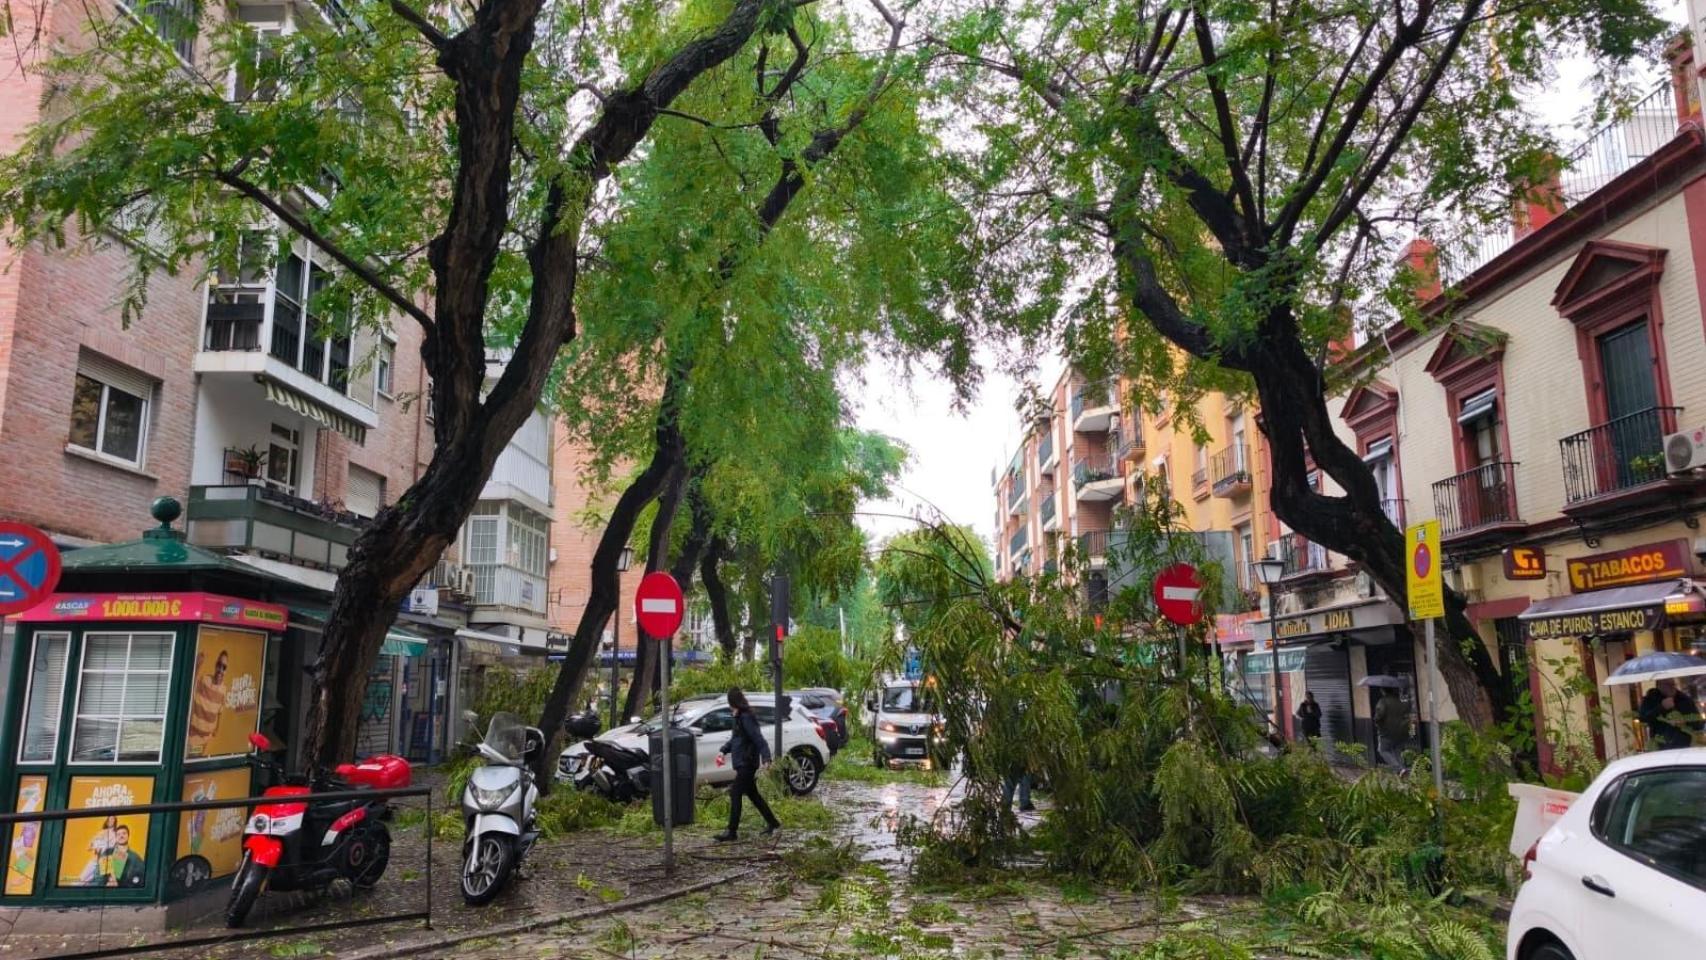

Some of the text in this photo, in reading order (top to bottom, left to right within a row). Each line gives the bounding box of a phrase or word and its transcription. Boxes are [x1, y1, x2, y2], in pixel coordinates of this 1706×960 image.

[1593, 552, 1665, 578] TABACOS
[102, 600, 168, 617] 1.000.000
[171, 600, 182, 617] €
[1324, 609, 1351, 630] LIDIA
[1529, 619, 1549, 637] CAVA
[1550, 618, 1562, 635] DE
[1563, 616, 1594, 635] PUROS
[1600, 610, 1645, 630] ESTANCO
[92, 783, 129, 798] AHORA
